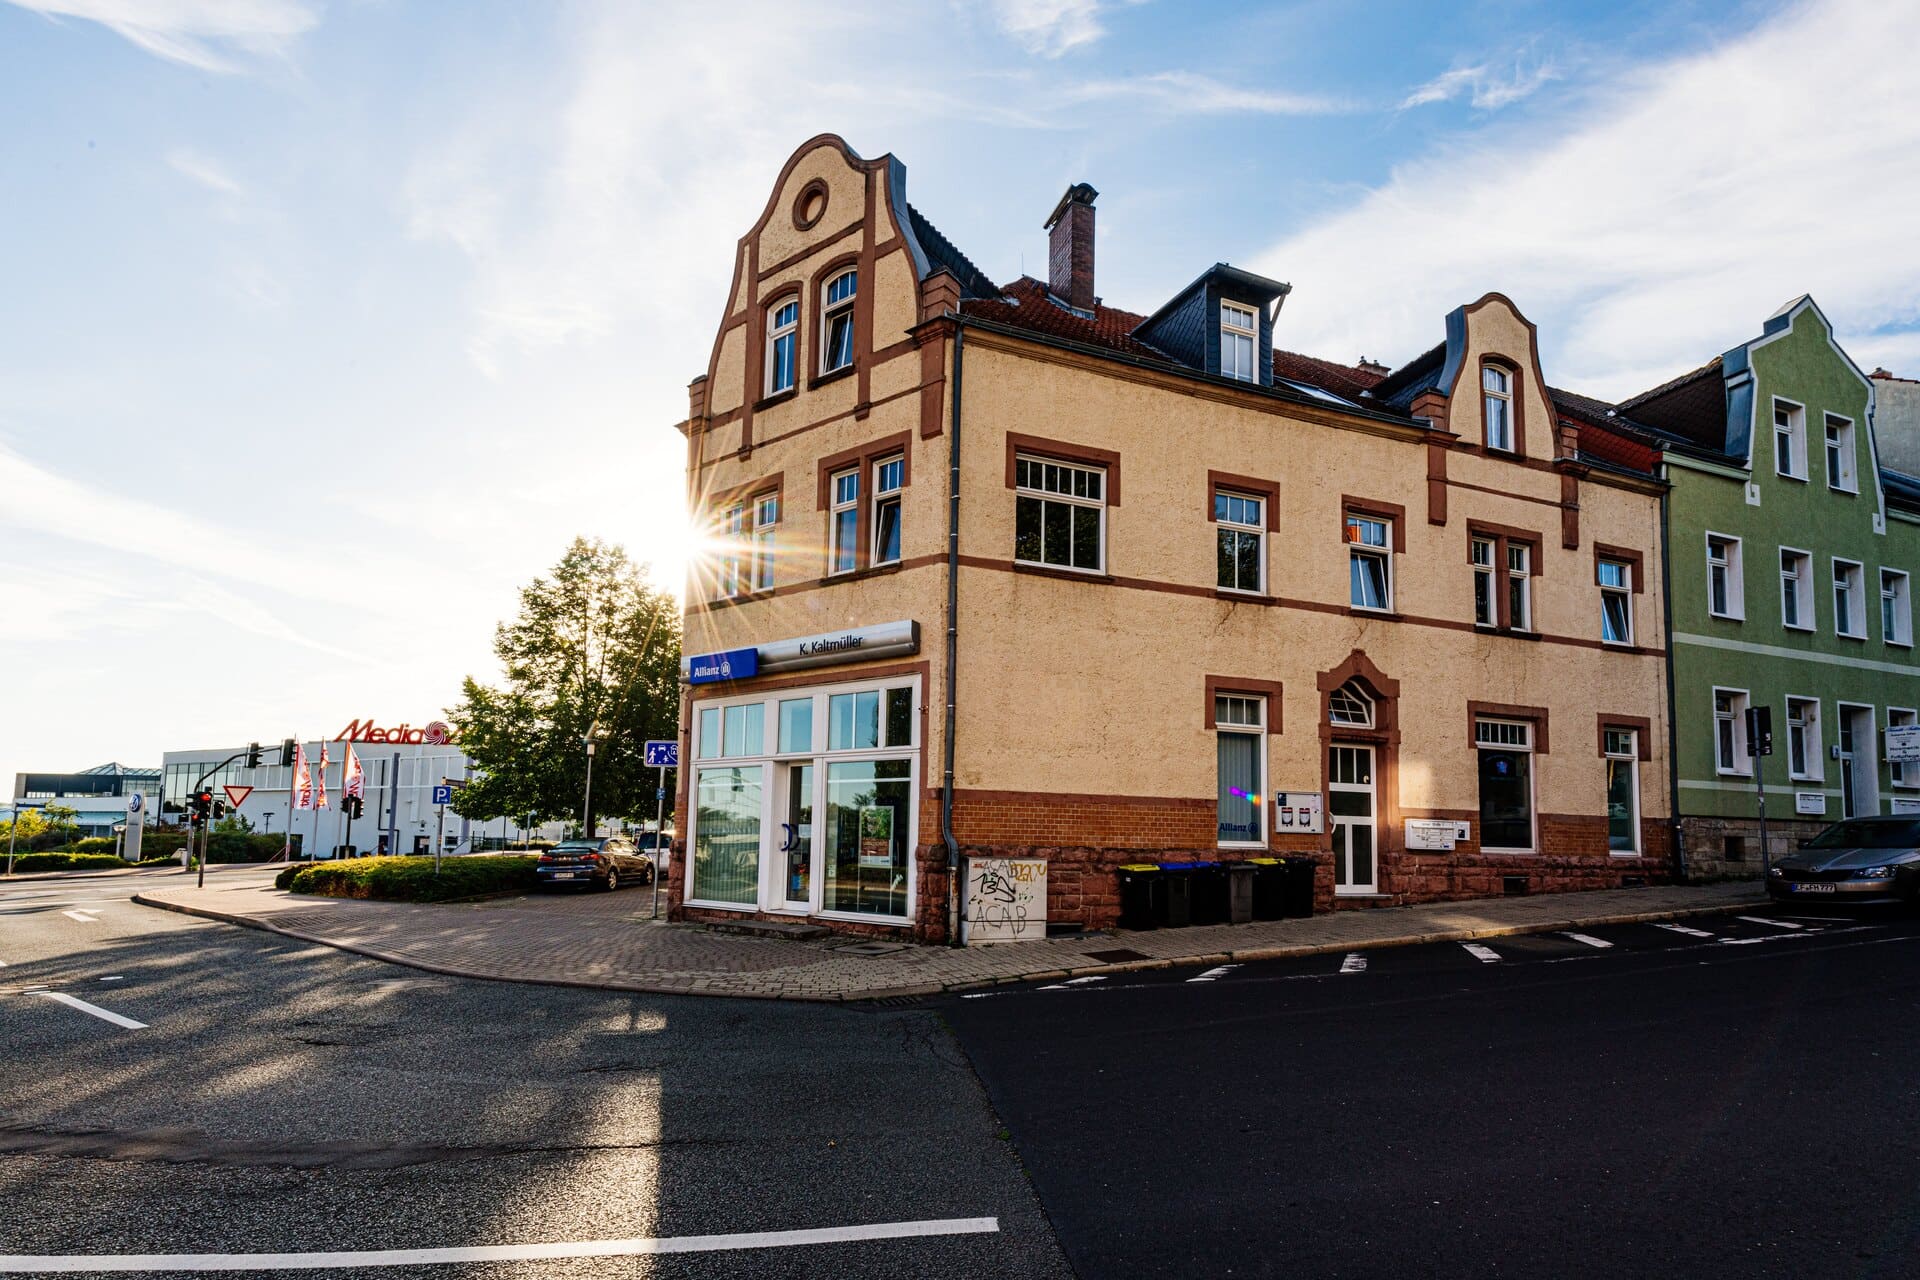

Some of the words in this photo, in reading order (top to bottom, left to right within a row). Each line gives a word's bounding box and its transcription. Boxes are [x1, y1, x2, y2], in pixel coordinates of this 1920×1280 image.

[799, 643, 809, 656] K.
[811, 634, 863, 654] Kaltmüller
[694, 666, 720, 678] Allianz
[333, 719, 425, 744] Media
[436, 788, 447, 802] P
[1219, 823, 1247, 833] Allianz
[972, 905, 1027, 936] ACAB
